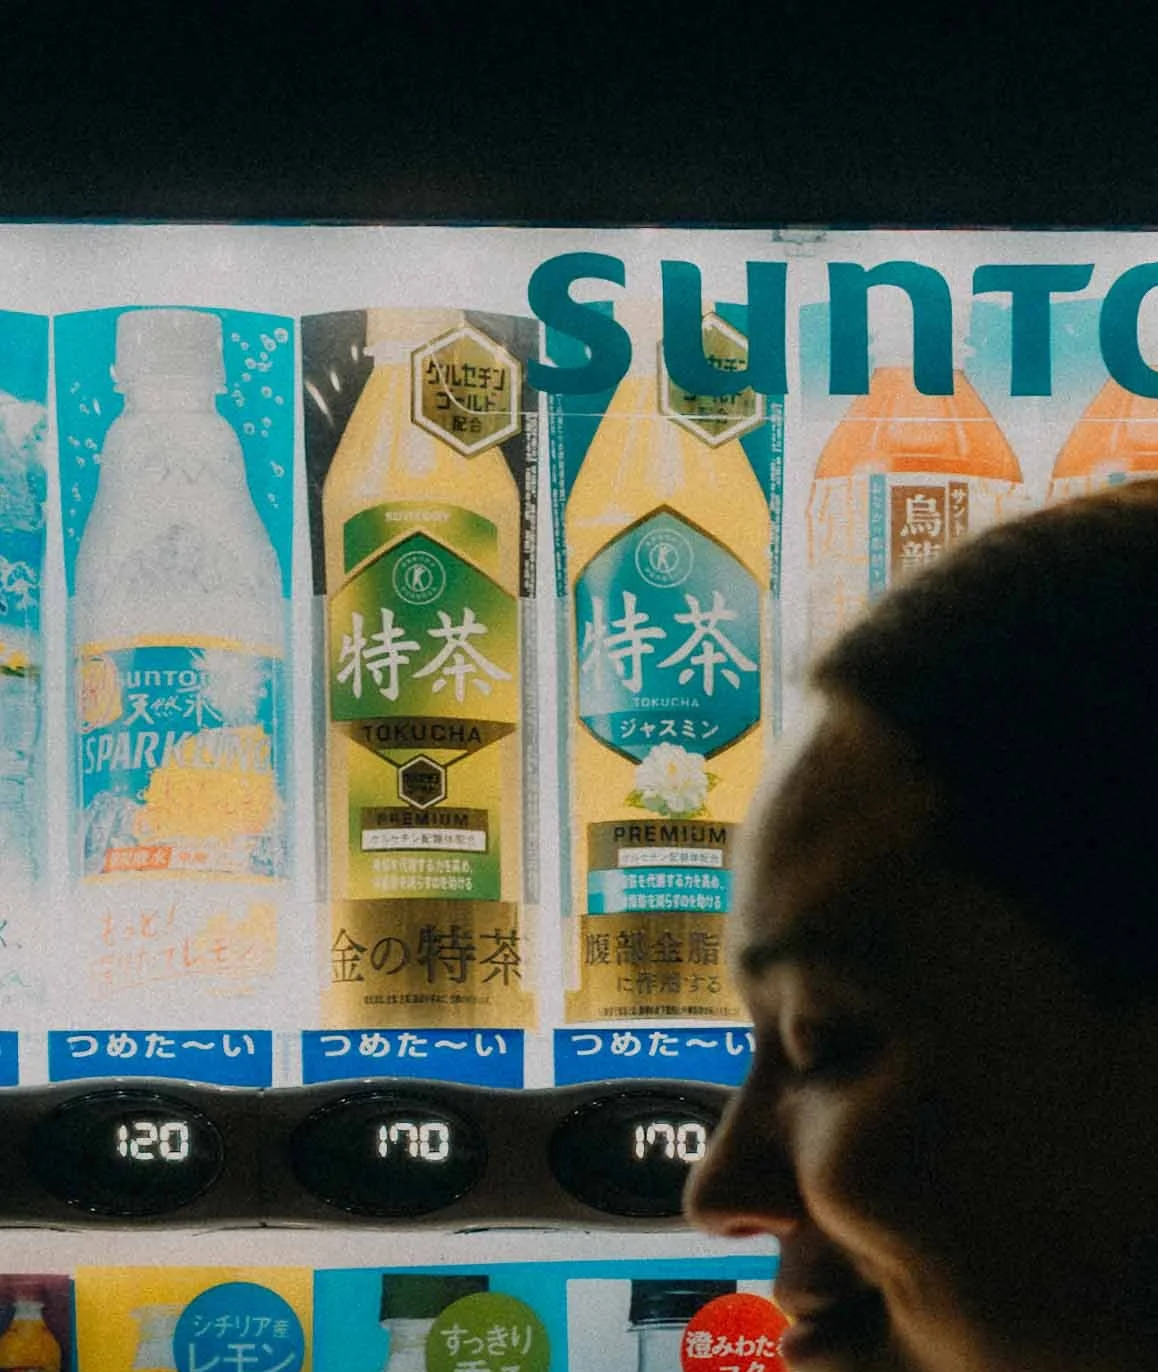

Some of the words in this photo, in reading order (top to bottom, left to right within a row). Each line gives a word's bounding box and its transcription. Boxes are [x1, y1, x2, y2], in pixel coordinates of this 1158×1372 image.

[334, 605, 514, 703] 特茶
[580, 590, 760, 698] 特茶
[122, 668, 212, 692] UNTO
[362, 722, 483, 744] TOKUCHA
[619, 717, 721, 739] ジャスミン
[612, 824, 728, 845] PREMIUM
[331, 921, 522, 986] 金の特茶
[116, 1121, 190, 1163] 120
[376, 1121, 450, 1163] 170
[633, 1122, 706, 1164] 170
[192, 1313, 291, 1340] シチリア産
[440, 1323, 533, 1357] すっきり
